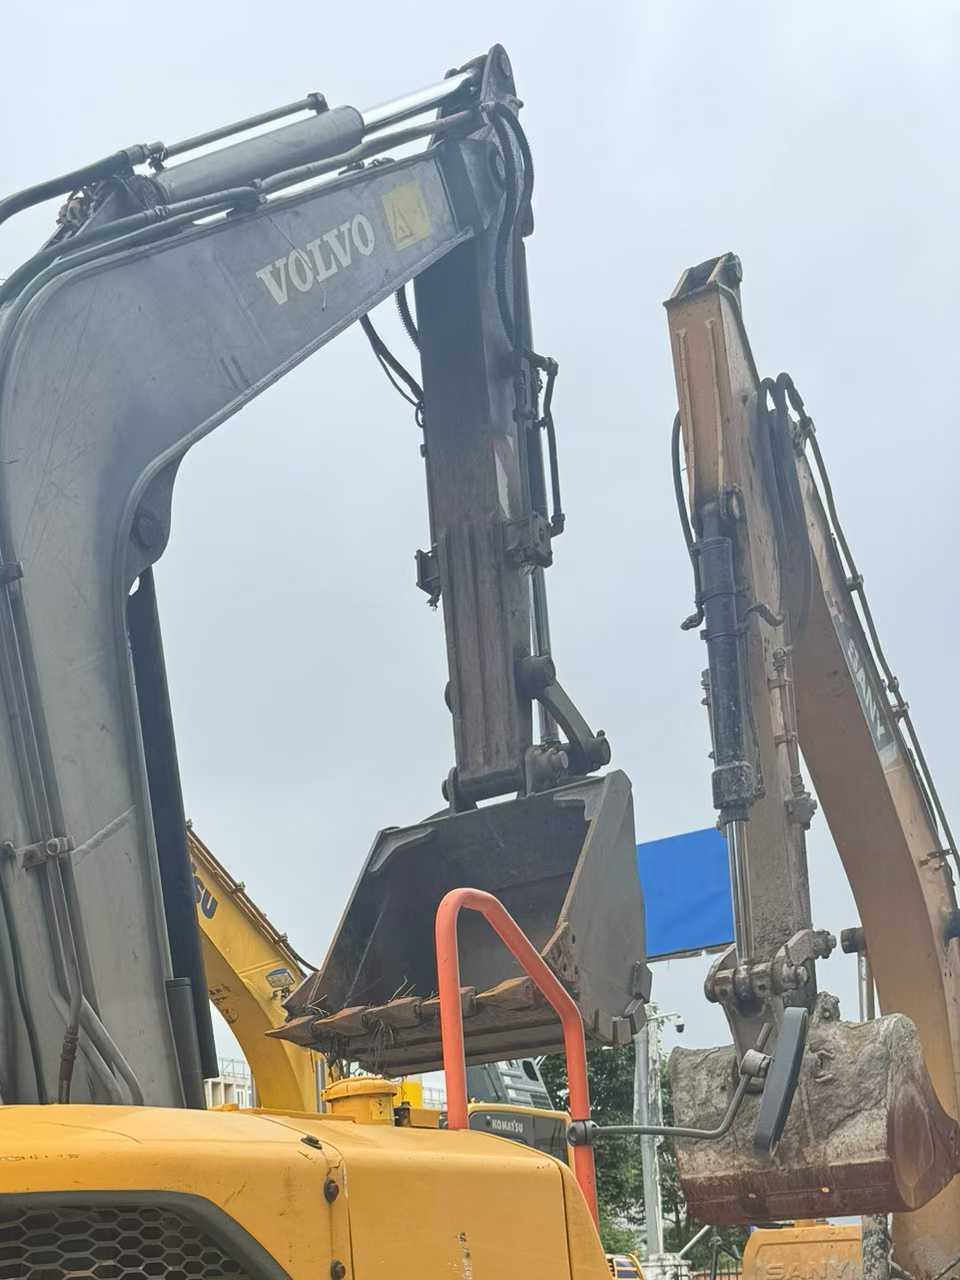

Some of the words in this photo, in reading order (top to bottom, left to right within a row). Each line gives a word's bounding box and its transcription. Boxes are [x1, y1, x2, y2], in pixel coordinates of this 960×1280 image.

[256, 214, 375, 305] VOLVO
[492, 1119, 524, 1134] KOMATSU
[766, 1262, 850, 1280] SANY
